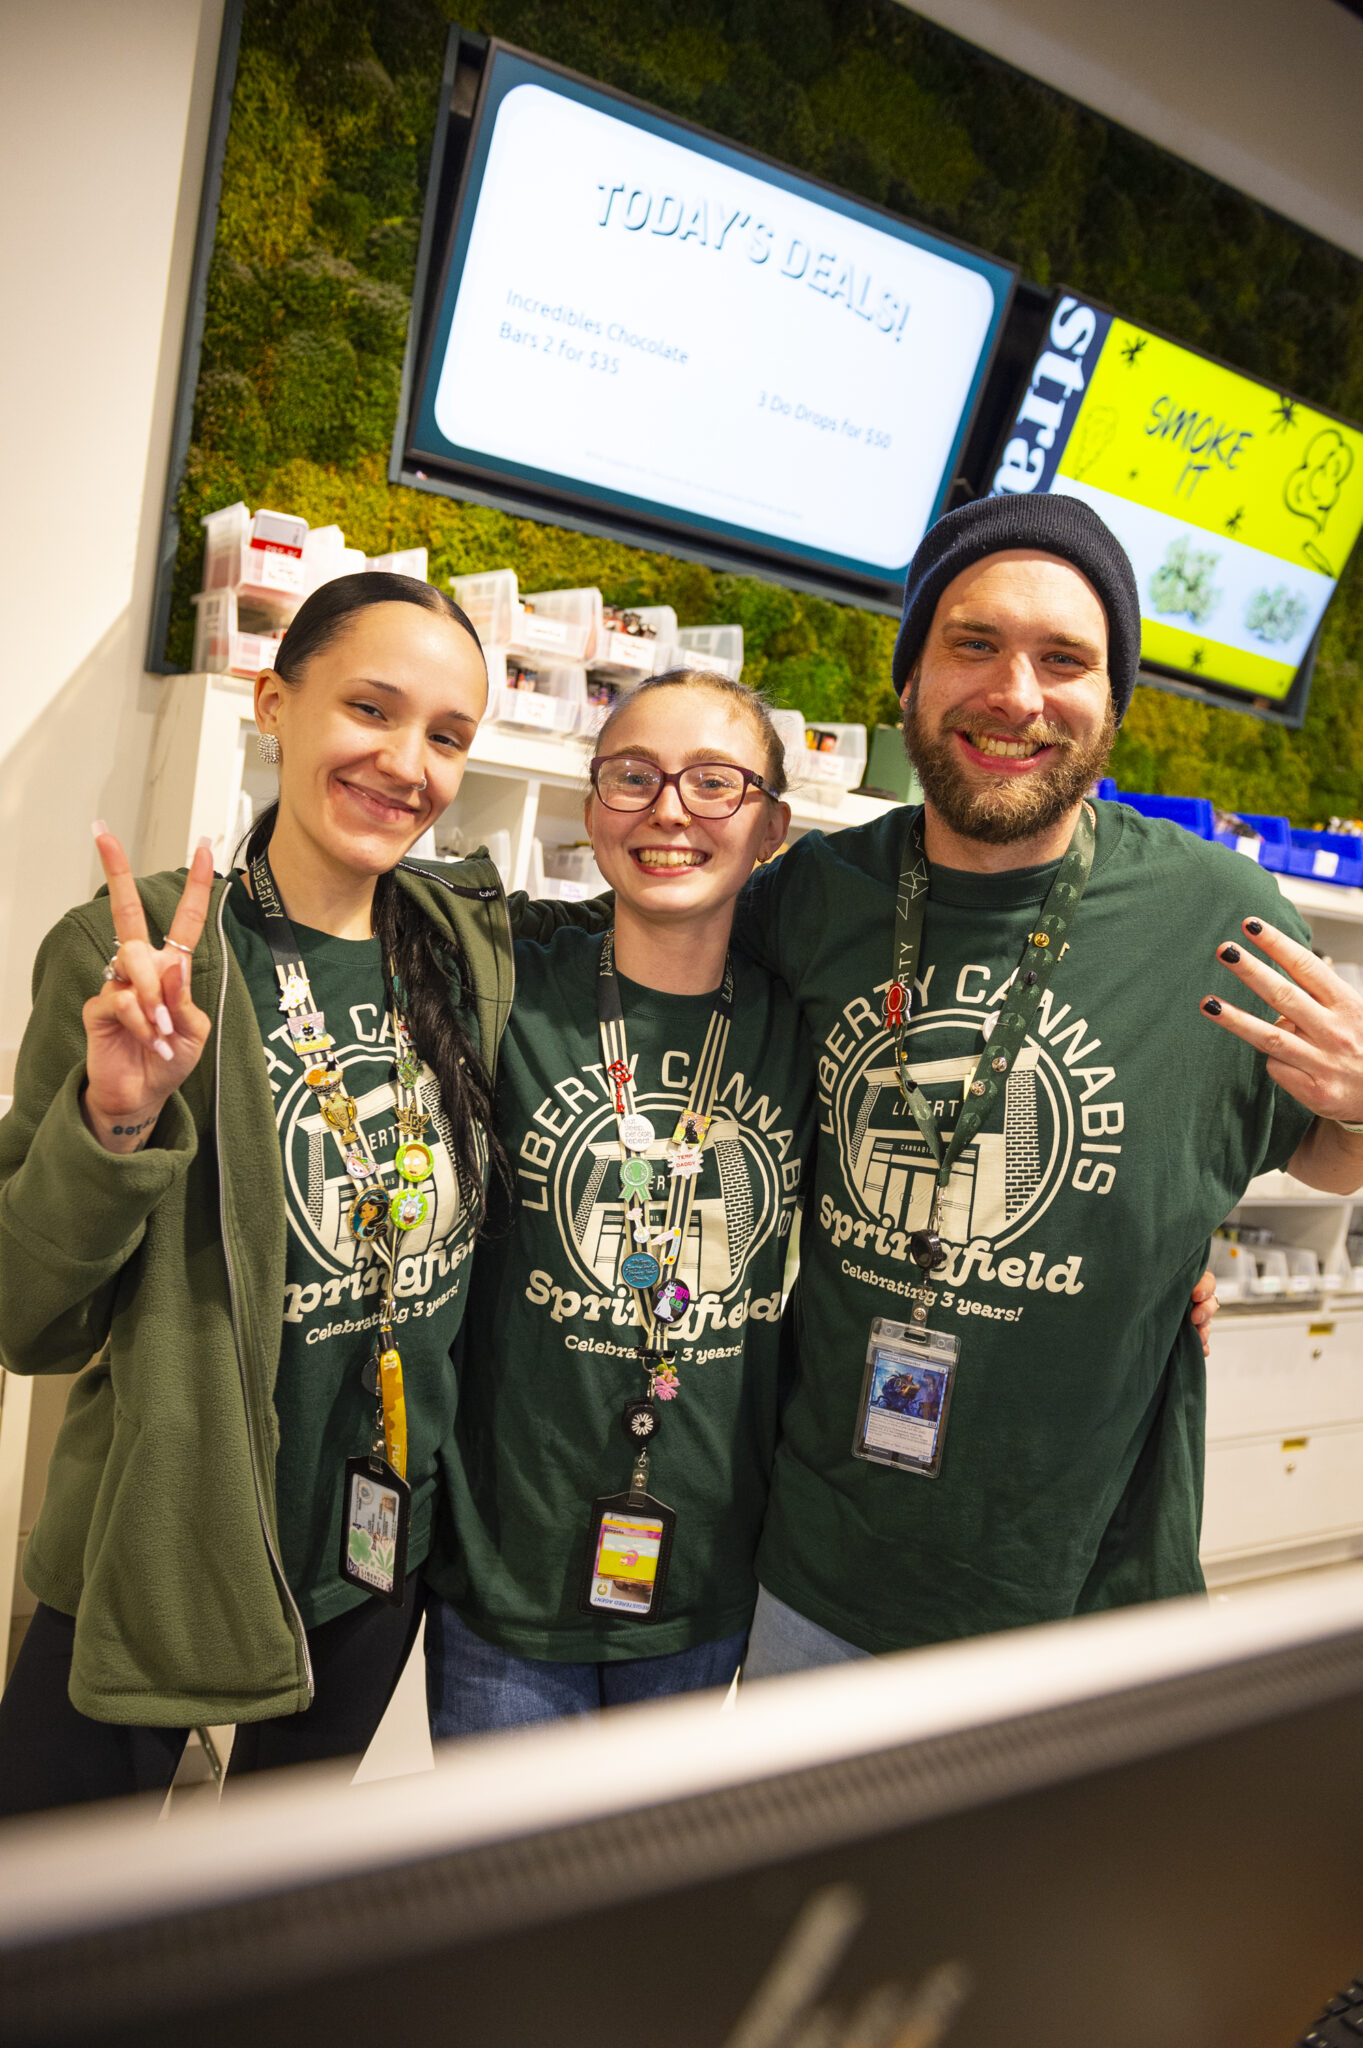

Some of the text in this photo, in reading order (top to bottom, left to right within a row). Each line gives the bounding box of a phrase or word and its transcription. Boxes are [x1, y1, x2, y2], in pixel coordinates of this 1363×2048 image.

[597, 182, 911, 343] TODAY'S DEALS!
[499, 321, 538, 349] Bars
[543, 335, 554, 353] 2
[558, 338, 584, 362] for
[506, 288, 690, 364] Incredibles Chocolate
[991, 296, 1097, 497] stra
[794, 403, 838, 432] Drops
[841, 417, 862, 439] for
[1145, 395, 1256, 470] SMOKE
[1174, 463, 1210, 499] IT
[478, 888, 498, 898] Calvin
[661, 1049, 802, 1238] CNNABIS
[412, 1301, 424, 1318] 3
[940, 1291, 956, 1308] 3
[956, 1298, 1024, 1322] years!
[681, 1347, 694, 1362] 3
